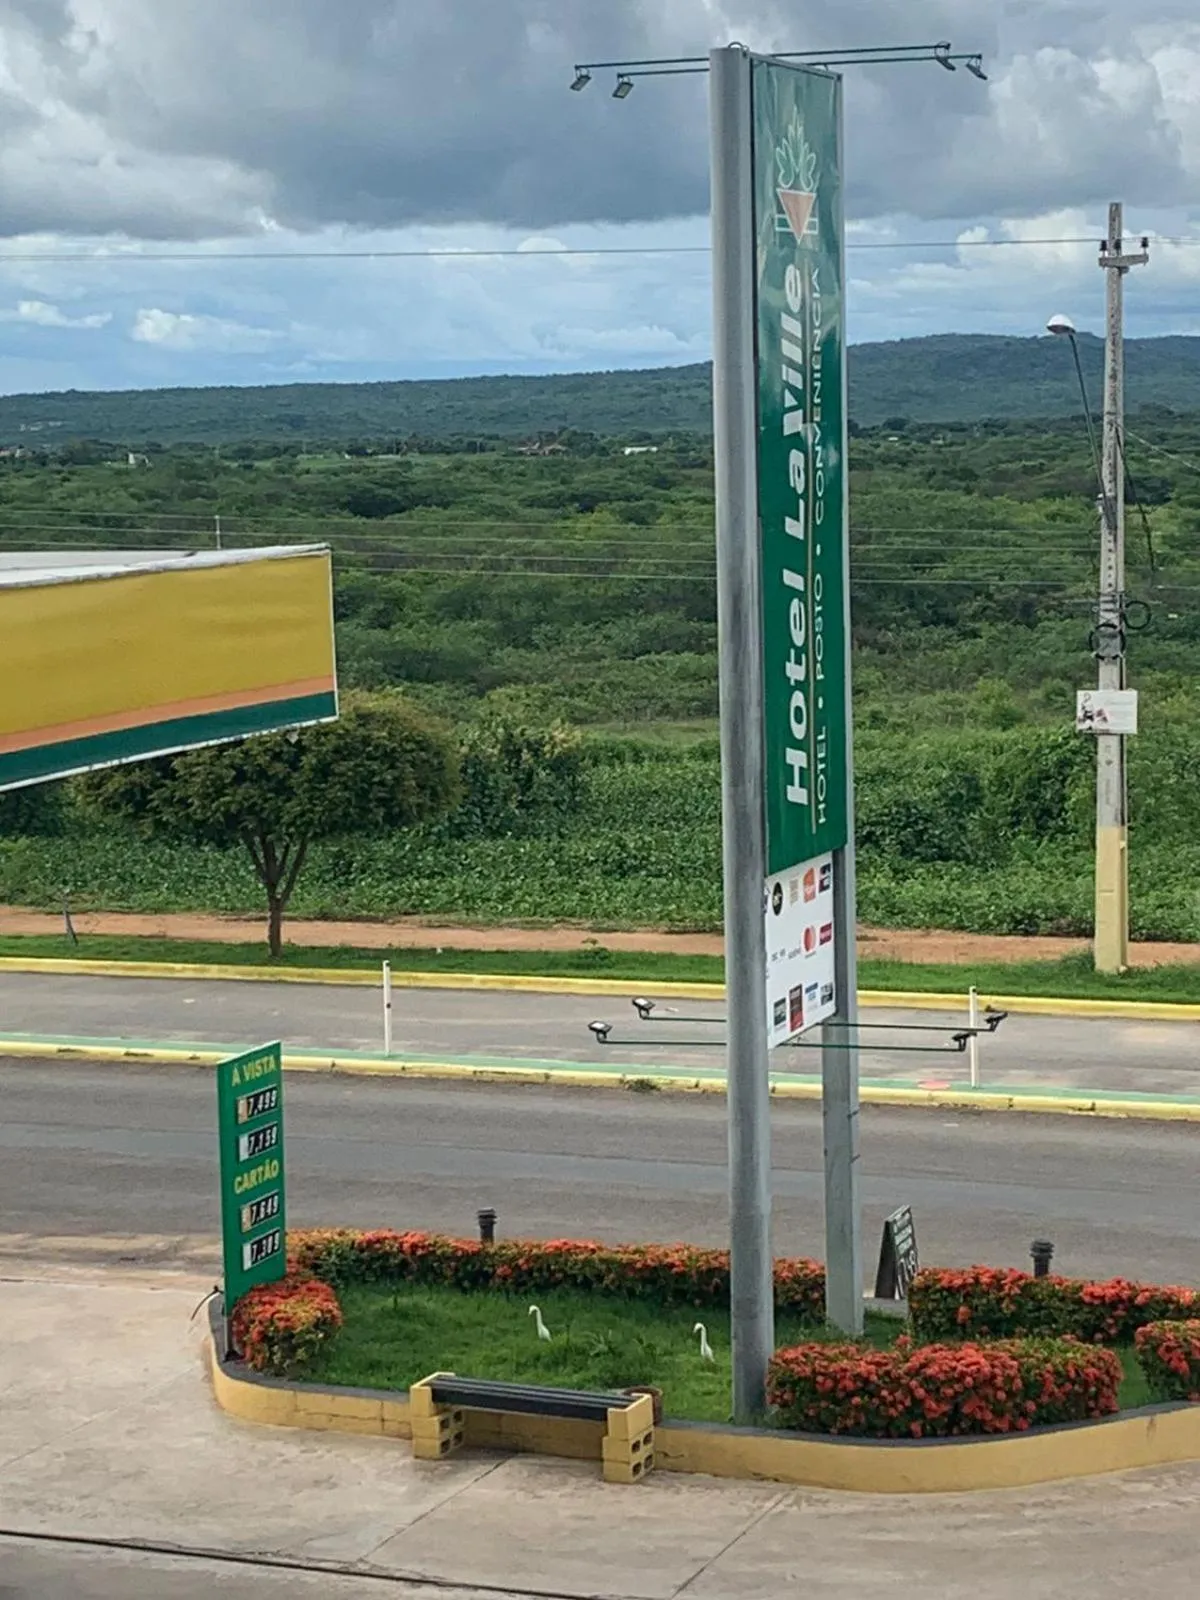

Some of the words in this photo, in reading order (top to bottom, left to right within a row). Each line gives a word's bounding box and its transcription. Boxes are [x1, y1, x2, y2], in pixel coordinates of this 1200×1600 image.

[812, 266, 824, 526] CONVENIÊNCIA
[814, 573, 824, 680] POSTO
[783, 568, 808, 806] Hotel
[816, 725, 827, 825] HOTEL
[242, 1055, 274, 1080] VISTA
[234, 1159, 279, 1192] CARTÃO
